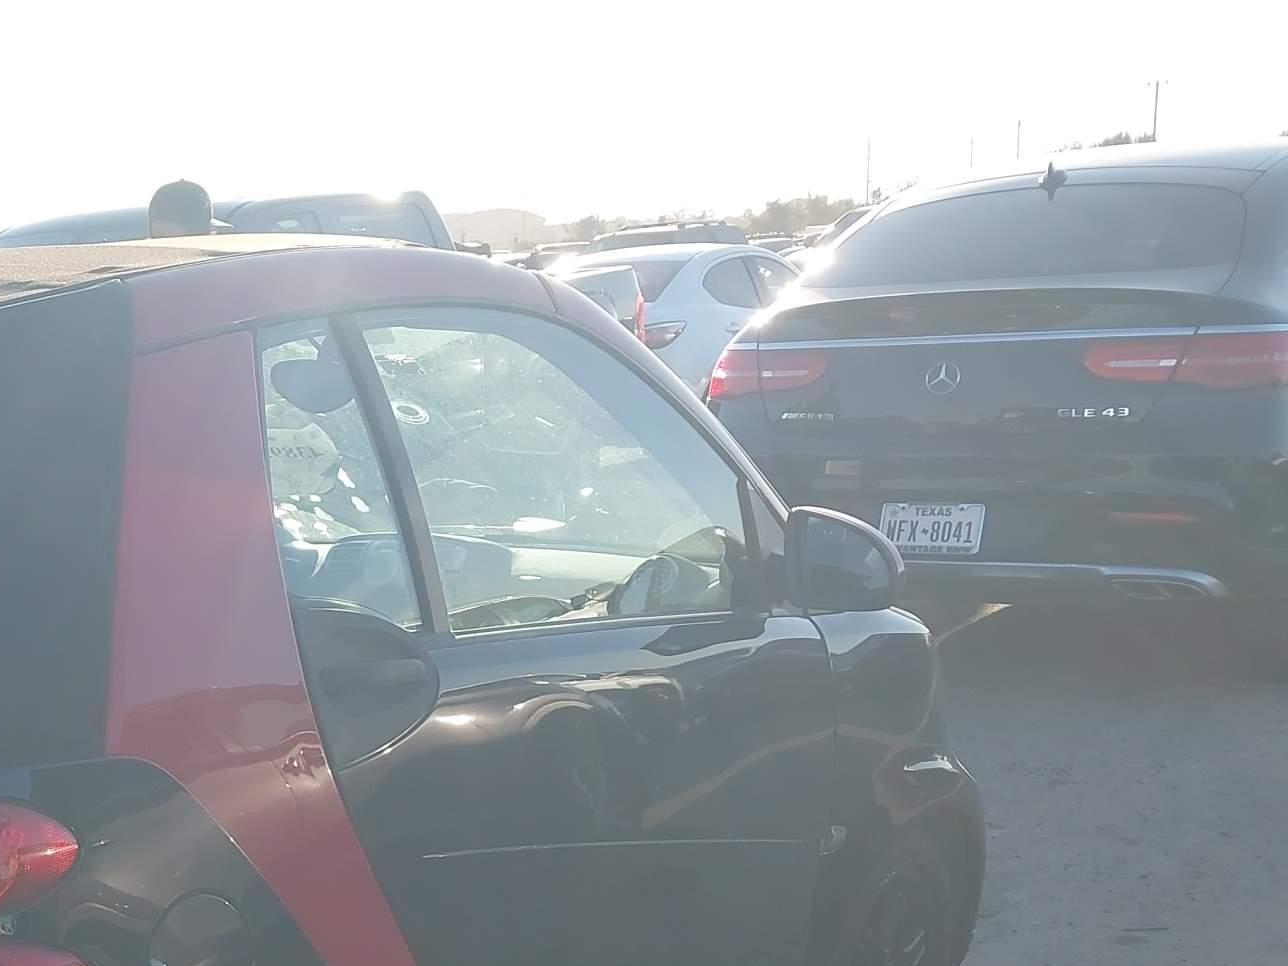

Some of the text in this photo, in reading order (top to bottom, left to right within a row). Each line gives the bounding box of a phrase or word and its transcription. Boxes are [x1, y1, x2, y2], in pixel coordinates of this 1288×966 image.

[1057, 407, 1130, 418] GLE 43
[915, 507, 952, 517] TEXAS
[929, 520, 973, 543] 8041
[896, 545, 945, 553] VANTAGE
